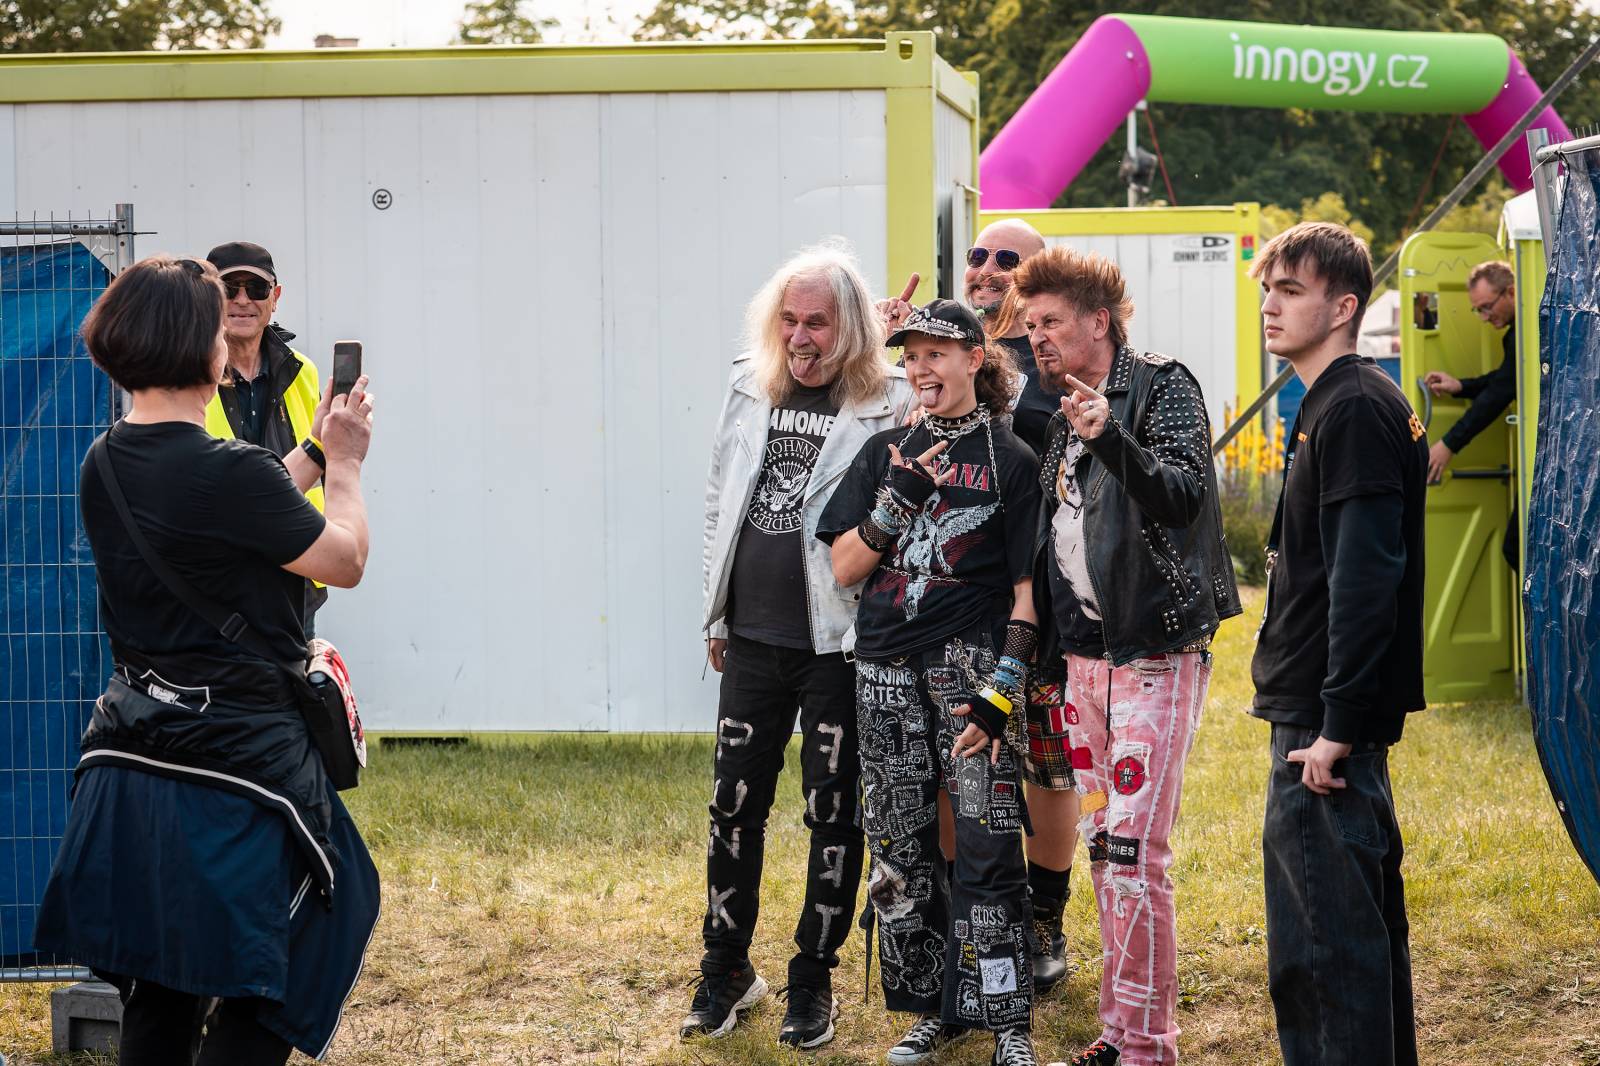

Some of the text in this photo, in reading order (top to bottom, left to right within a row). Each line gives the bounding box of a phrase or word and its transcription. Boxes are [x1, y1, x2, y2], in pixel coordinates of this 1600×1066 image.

[1229, 32, 1430, 97] innogy.cz
[769, 408, 835, 437] AMONE
[766, 439, 820, 464] JOHNNY
[863, 683, 906, 706] BITES
[965, 804, 978, 812] ART
[708, 717, 754, 930] PUNK
[972, 908, 1006, 926] GLOSS
